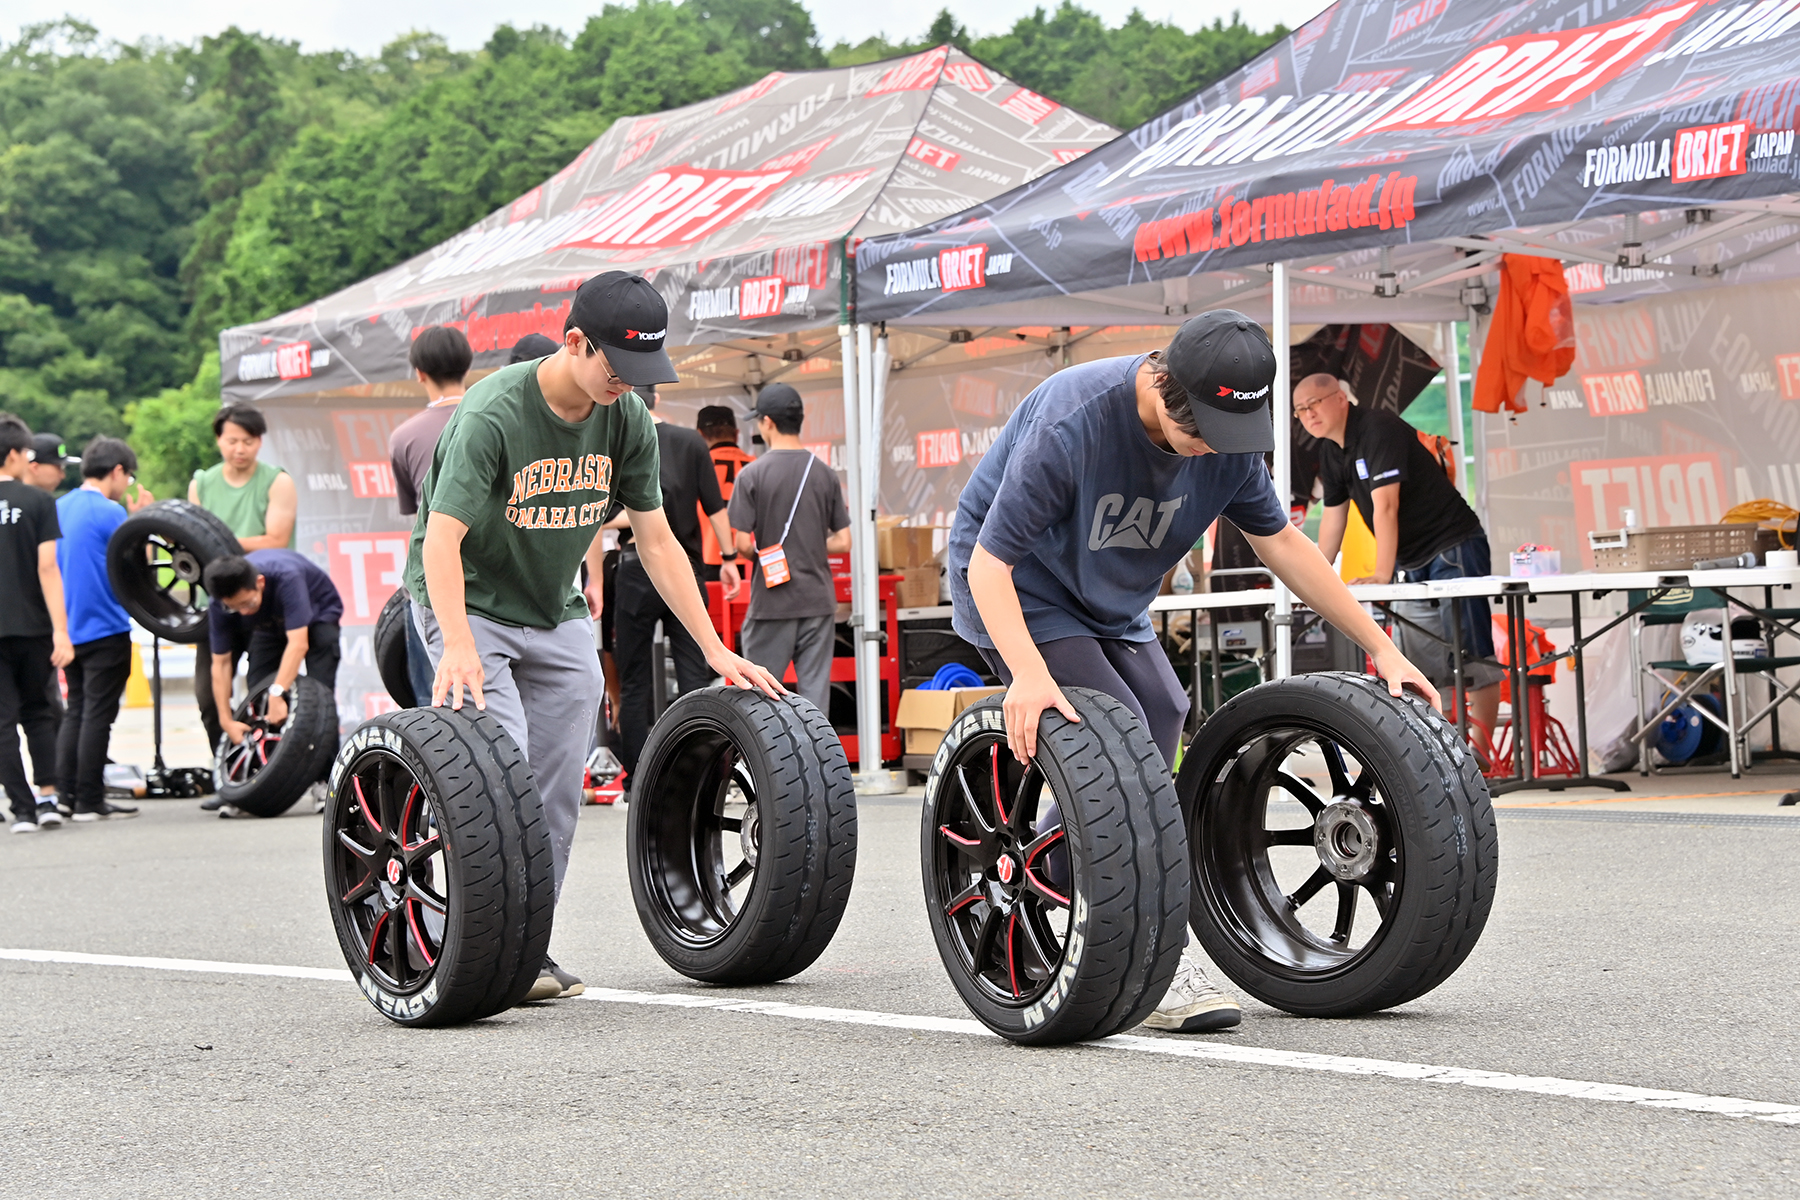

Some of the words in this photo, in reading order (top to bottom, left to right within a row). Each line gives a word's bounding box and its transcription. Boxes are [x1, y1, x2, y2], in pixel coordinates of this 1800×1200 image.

[1002, 88, 1054, 125] DRIF
[1096, 75, 1434, 187] FORMULA
[1364, 2, 1698, 133] DRIFT
[692, 83, 836, 170] FORMULA
[907, 140, 957, 169] IFT
[961, 165, 1012, 186] JAPAN
[1512, 121, 1604, 212] FORMULA
[1583, 139, 1671, 188] FORMULA
[1676, 123, 1746, 179] DRIFT
[1751, 130, 1795, 160] JAPAN
[563, 169, 793, 246] DRIFT
[1134, 171, 1418, 263] www.formulad.jp
[689, 286, 740, 321] FORMULA
[742, 277, 782, 317] DRIFT
[884, 257, 942, 296] FORMULA
[942, 247, 984, 290] DRIFT
[986, 253, 1013, 276] JAPAN
[507, 453, 613, 505] NEBRASK
[0, 507, 22, 525] FF
[505, 505, 577, 530] OMAHA
[1087, 492, 1184, 551] CAT
[331, 725, 403, 791] ADVAN
[926, 710, 1004, 807] ADVAN
[360, 971, 440, 1020] ADVAN
